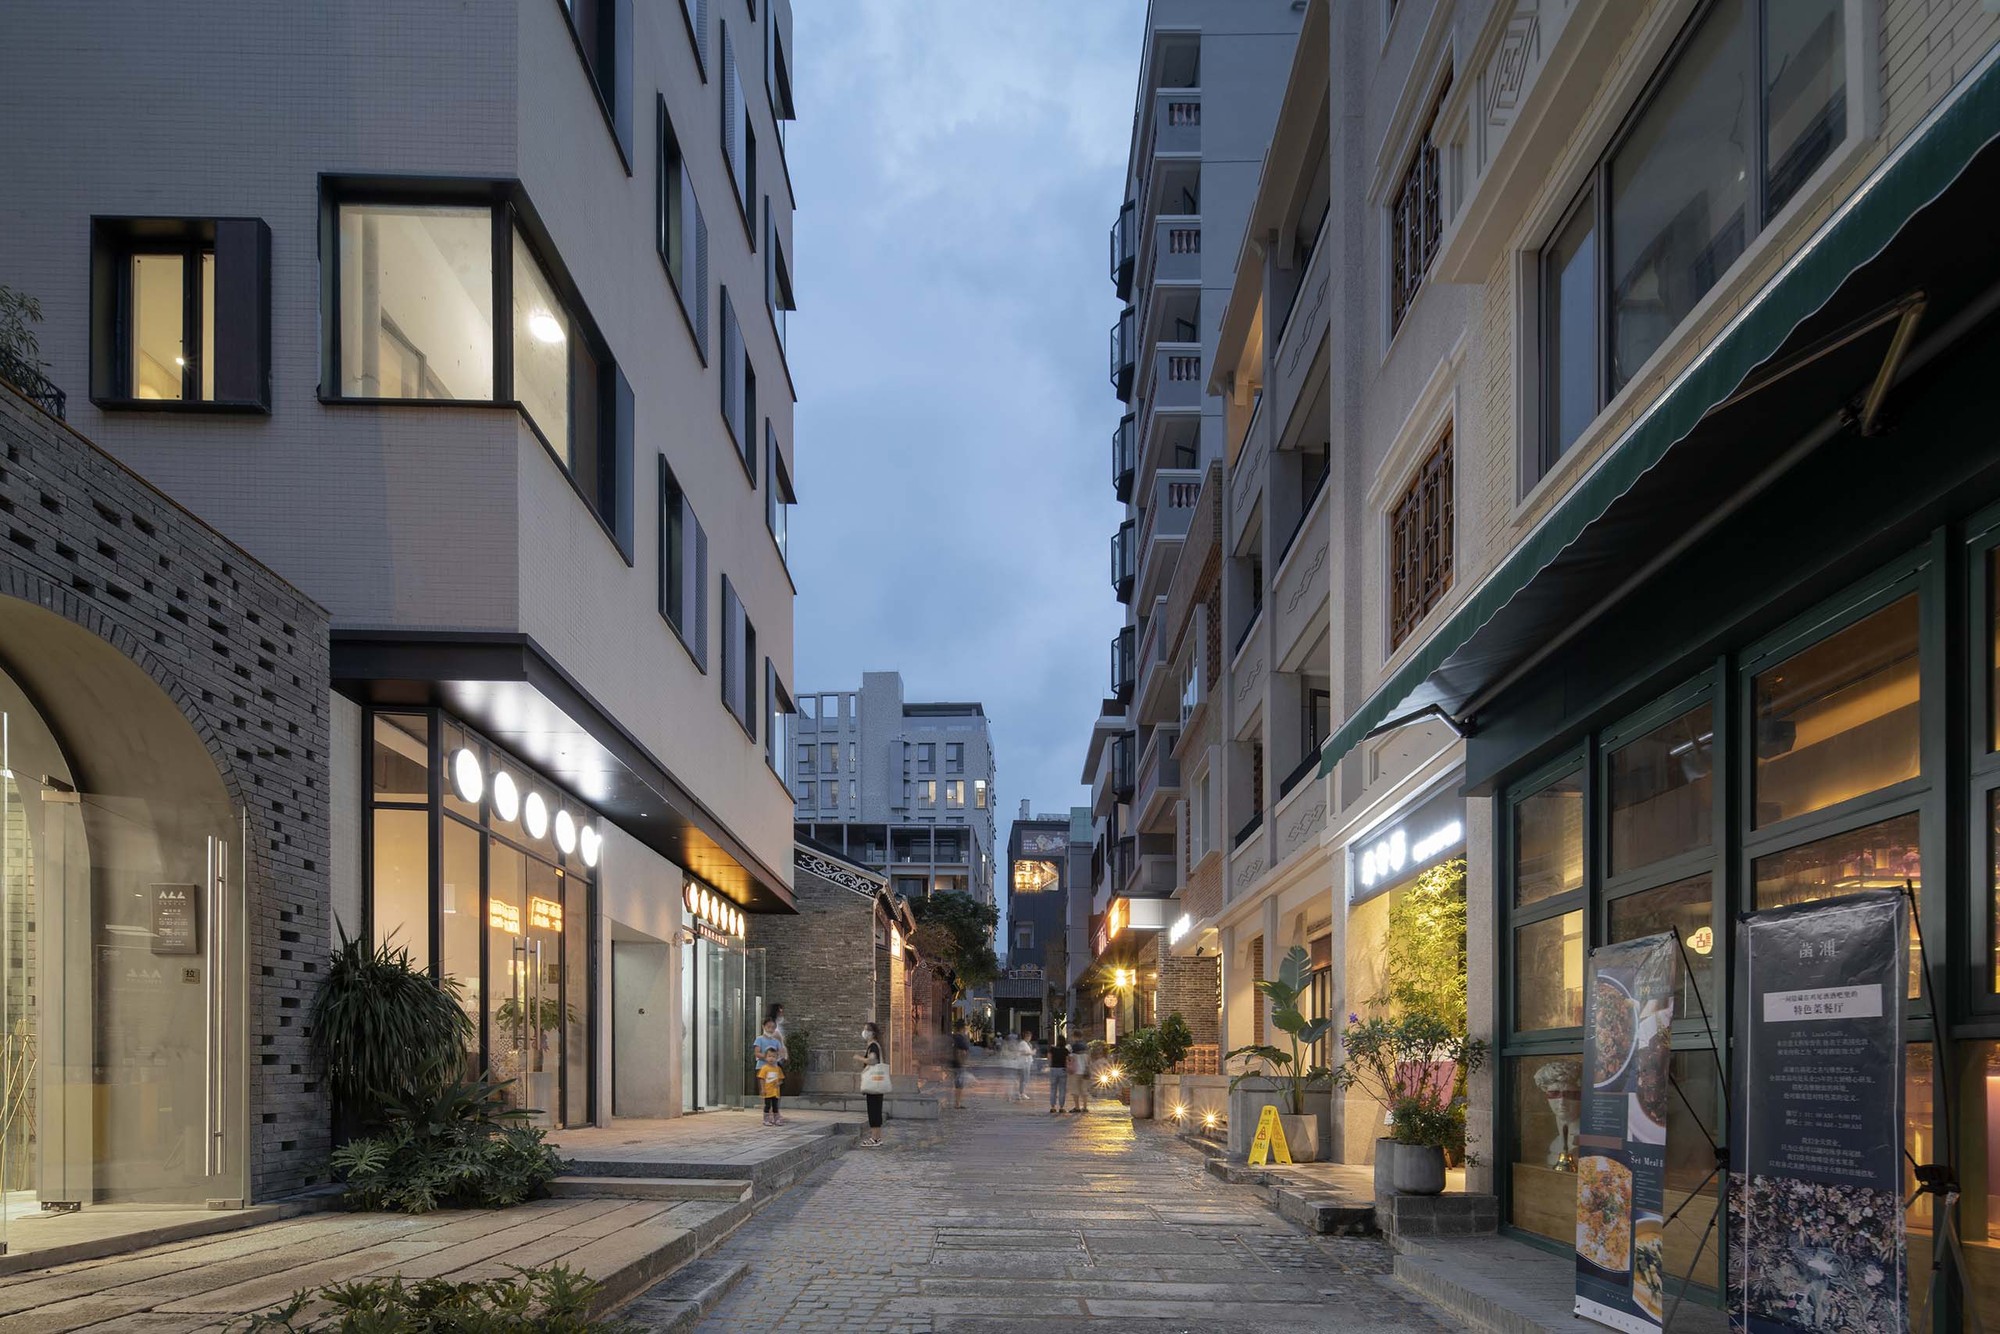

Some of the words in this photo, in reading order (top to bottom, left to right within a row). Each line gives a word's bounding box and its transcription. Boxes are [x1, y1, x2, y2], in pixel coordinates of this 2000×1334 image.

[1793, 1003, 1844, 1016] 特色菜餐厅
